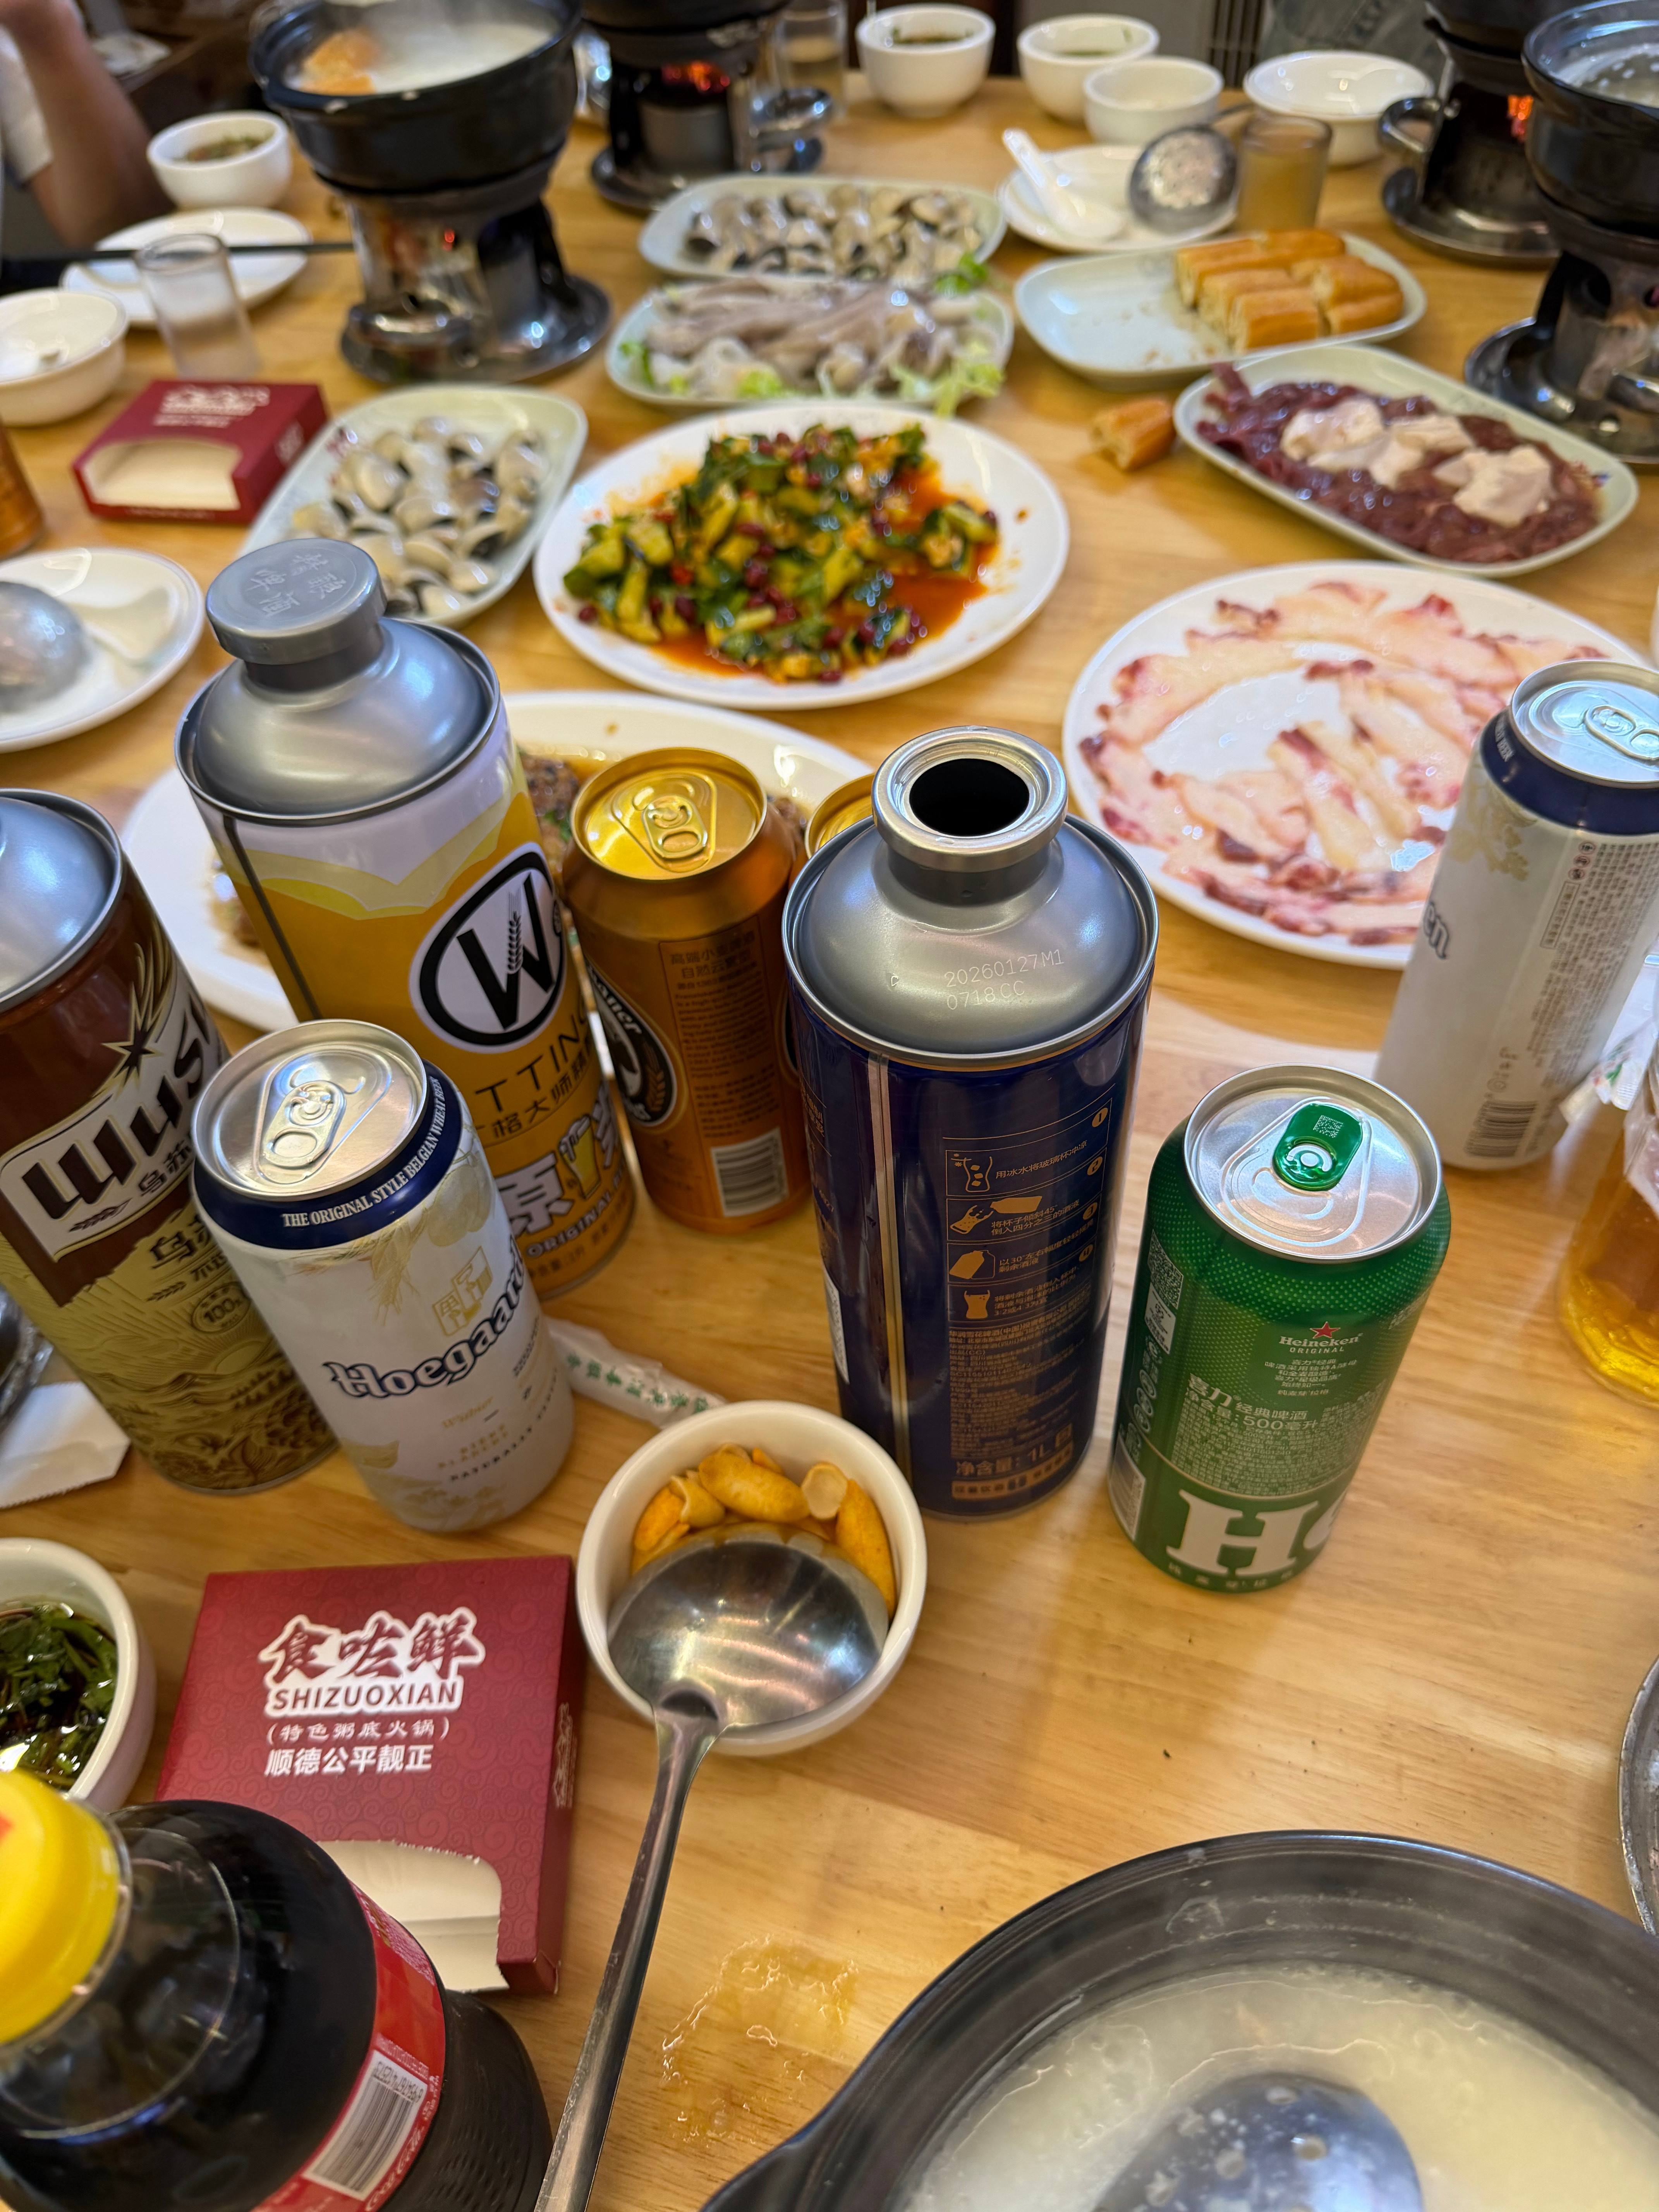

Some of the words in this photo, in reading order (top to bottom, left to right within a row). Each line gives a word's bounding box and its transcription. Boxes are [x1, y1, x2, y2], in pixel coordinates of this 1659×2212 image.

[945, 949, 1065, 988] 20260127M1
[946, 981, 1025, 1010] 0718CC
[429, 1076, 445, 1102] BEER
[429, 1098, 446, 1135] WHEAT
[403, 1132, 439, 1179] BELGIAN
[370, 1171, 409, 1204] STYLE
[281, 1212, 309, 1227] THE
[311, 1195, 373, 1226] ORIGINAL
[1279, 1336, 1359, 1347] Heineken
[1290, 1346, 1345, 1354] ORIGINAL
[272, 1681, 457, 1710] SHIZUOXIAN
[266, 1716, 450, 1745] (特色粥底火锅)
[264, 1744, 434, 1777] 顺德公平靓正
